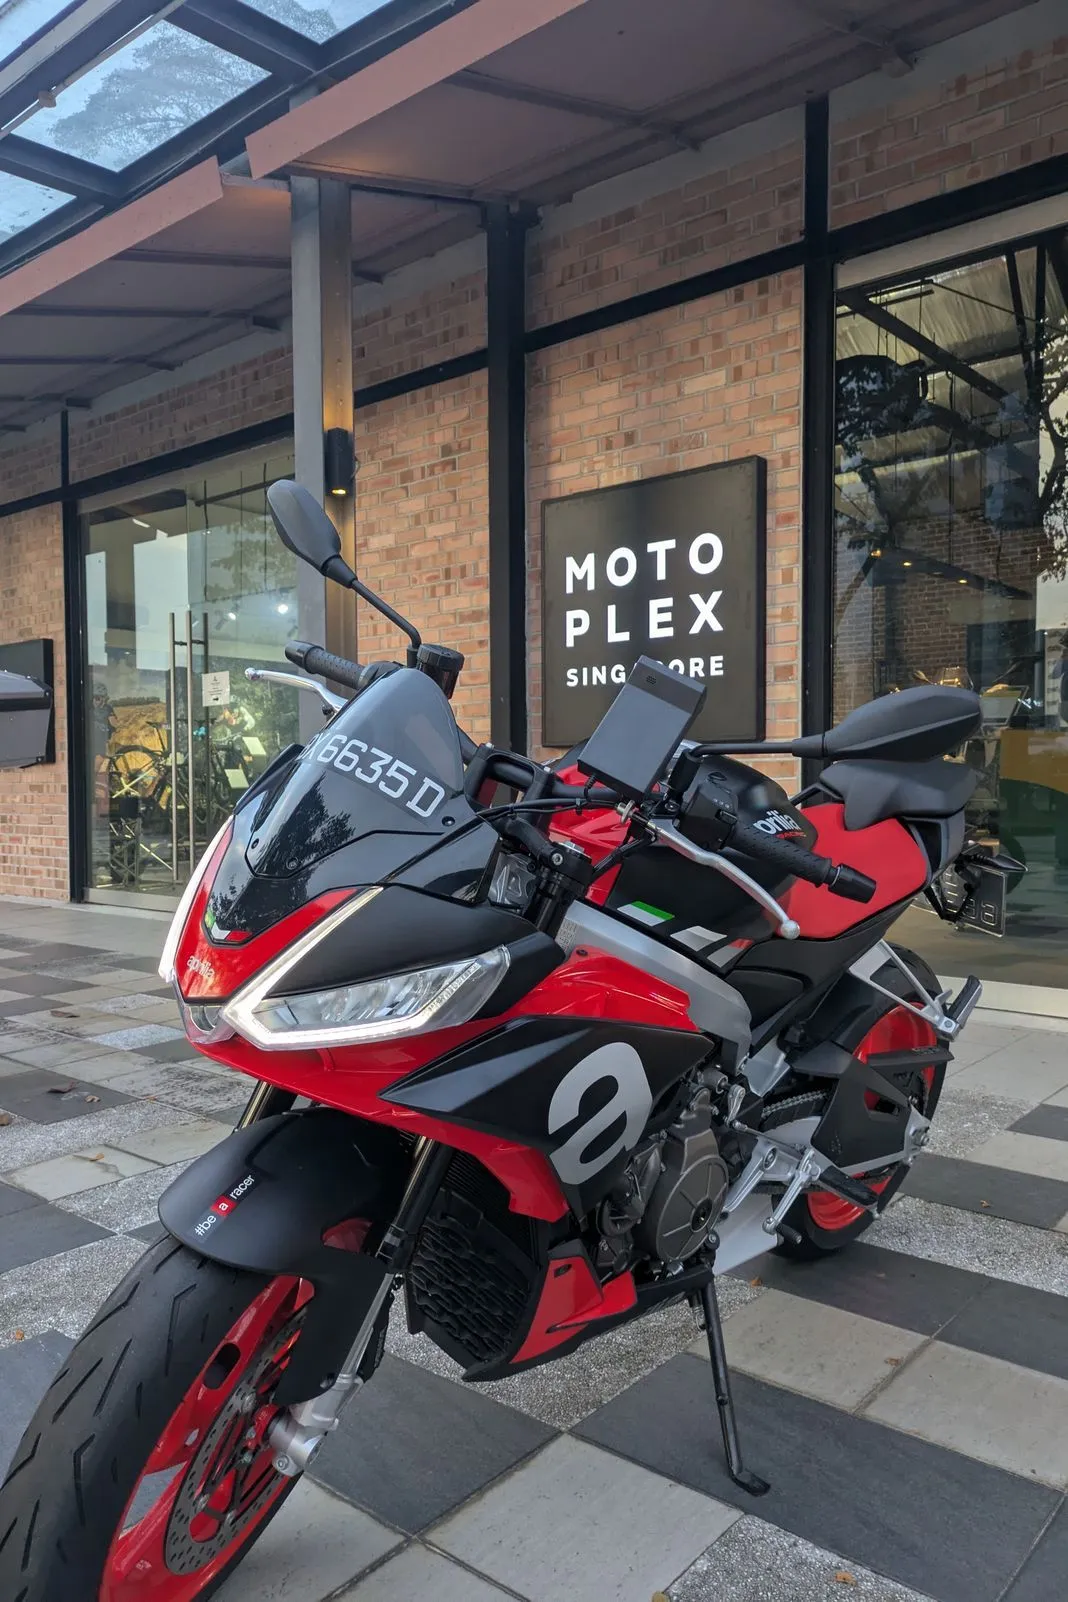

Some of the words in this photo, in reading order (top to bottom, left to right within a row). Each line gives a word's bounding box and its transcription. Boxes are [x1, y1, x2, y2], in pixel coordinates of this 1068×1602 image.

[566, 532, 724, 595] MOTO
[566, 590, 724, 648] PLEX
[566, 655, 724, 688] SINGORE
[194, 1215, 217, 1237] #be
[218, 1202, 229, 1211] a
[229, 1174, 255, 1200] racer
